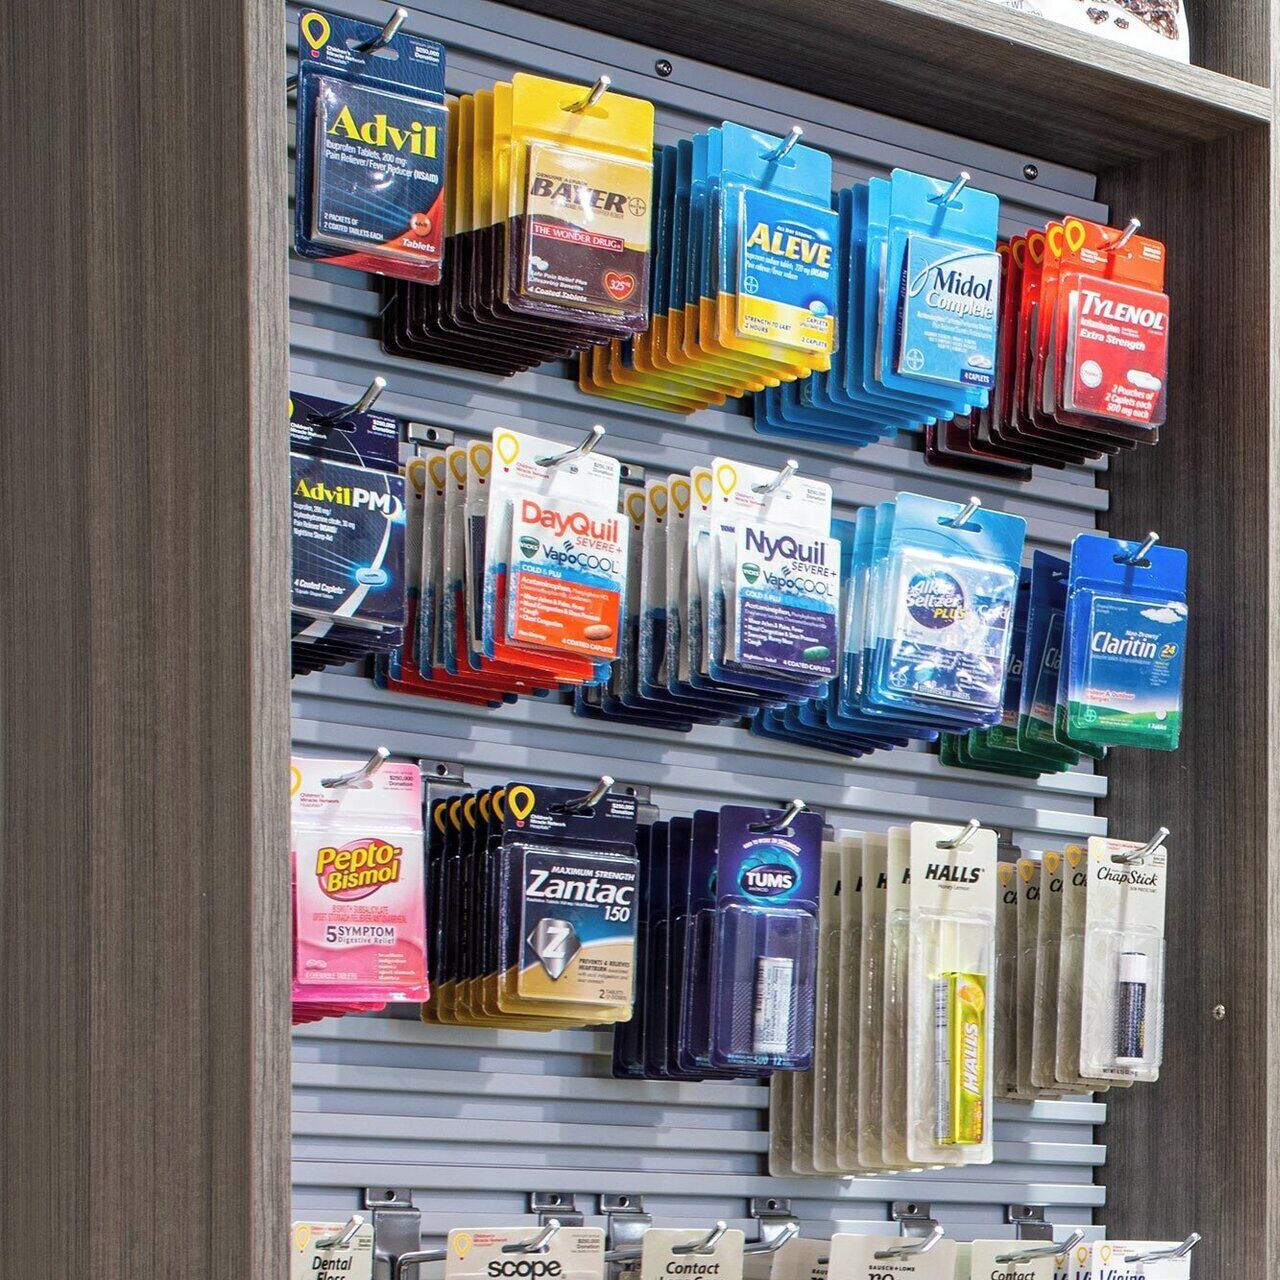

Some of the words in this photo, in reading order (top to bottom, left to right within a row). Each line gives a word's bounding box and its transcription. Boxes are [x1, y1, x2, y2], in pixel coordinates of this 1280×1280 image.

[329, 105, 437, 159] Advil
[531, 178, 629, 212] BAYER
[747, 226, 831, 267] ALEVE
[933, 267, 993, 301] Midol
[926, 291, 993, 320] Complete
[1080, 289, 1165, 330] TYLENOL
[1079, 329, 1105, 342] Extra
[1107, 335, 1145, 351] Strength
[294, 479, 351, 506] Advil
[520, 499, 619, 542] DayQuil
[745, 528, 826, 565] NyQuil
[1092, 630, 1157, 658] Claritin
[326, 862, 399, 892] Bismol
[551, 866, 592, 877] MAXIMUM
[594, 870, 634, 881] STRENGTH
[745, 871, 793, 890] TUMS
[926, 863, 981, 883] HALLS
[1096, 867, 1157, 887] ChapStick
[526, 871, 633, 905] Zantac
[605, 906, 629, 922] 150
[338, 925, 395, 938] SYMPTOM
[963, 1023, 978, 1095] HALLS
[312, 1256, 353, 1271] Dental
[488, 1259, 561, 1280] scope
[666, 1261, 719, 1274] Contact
